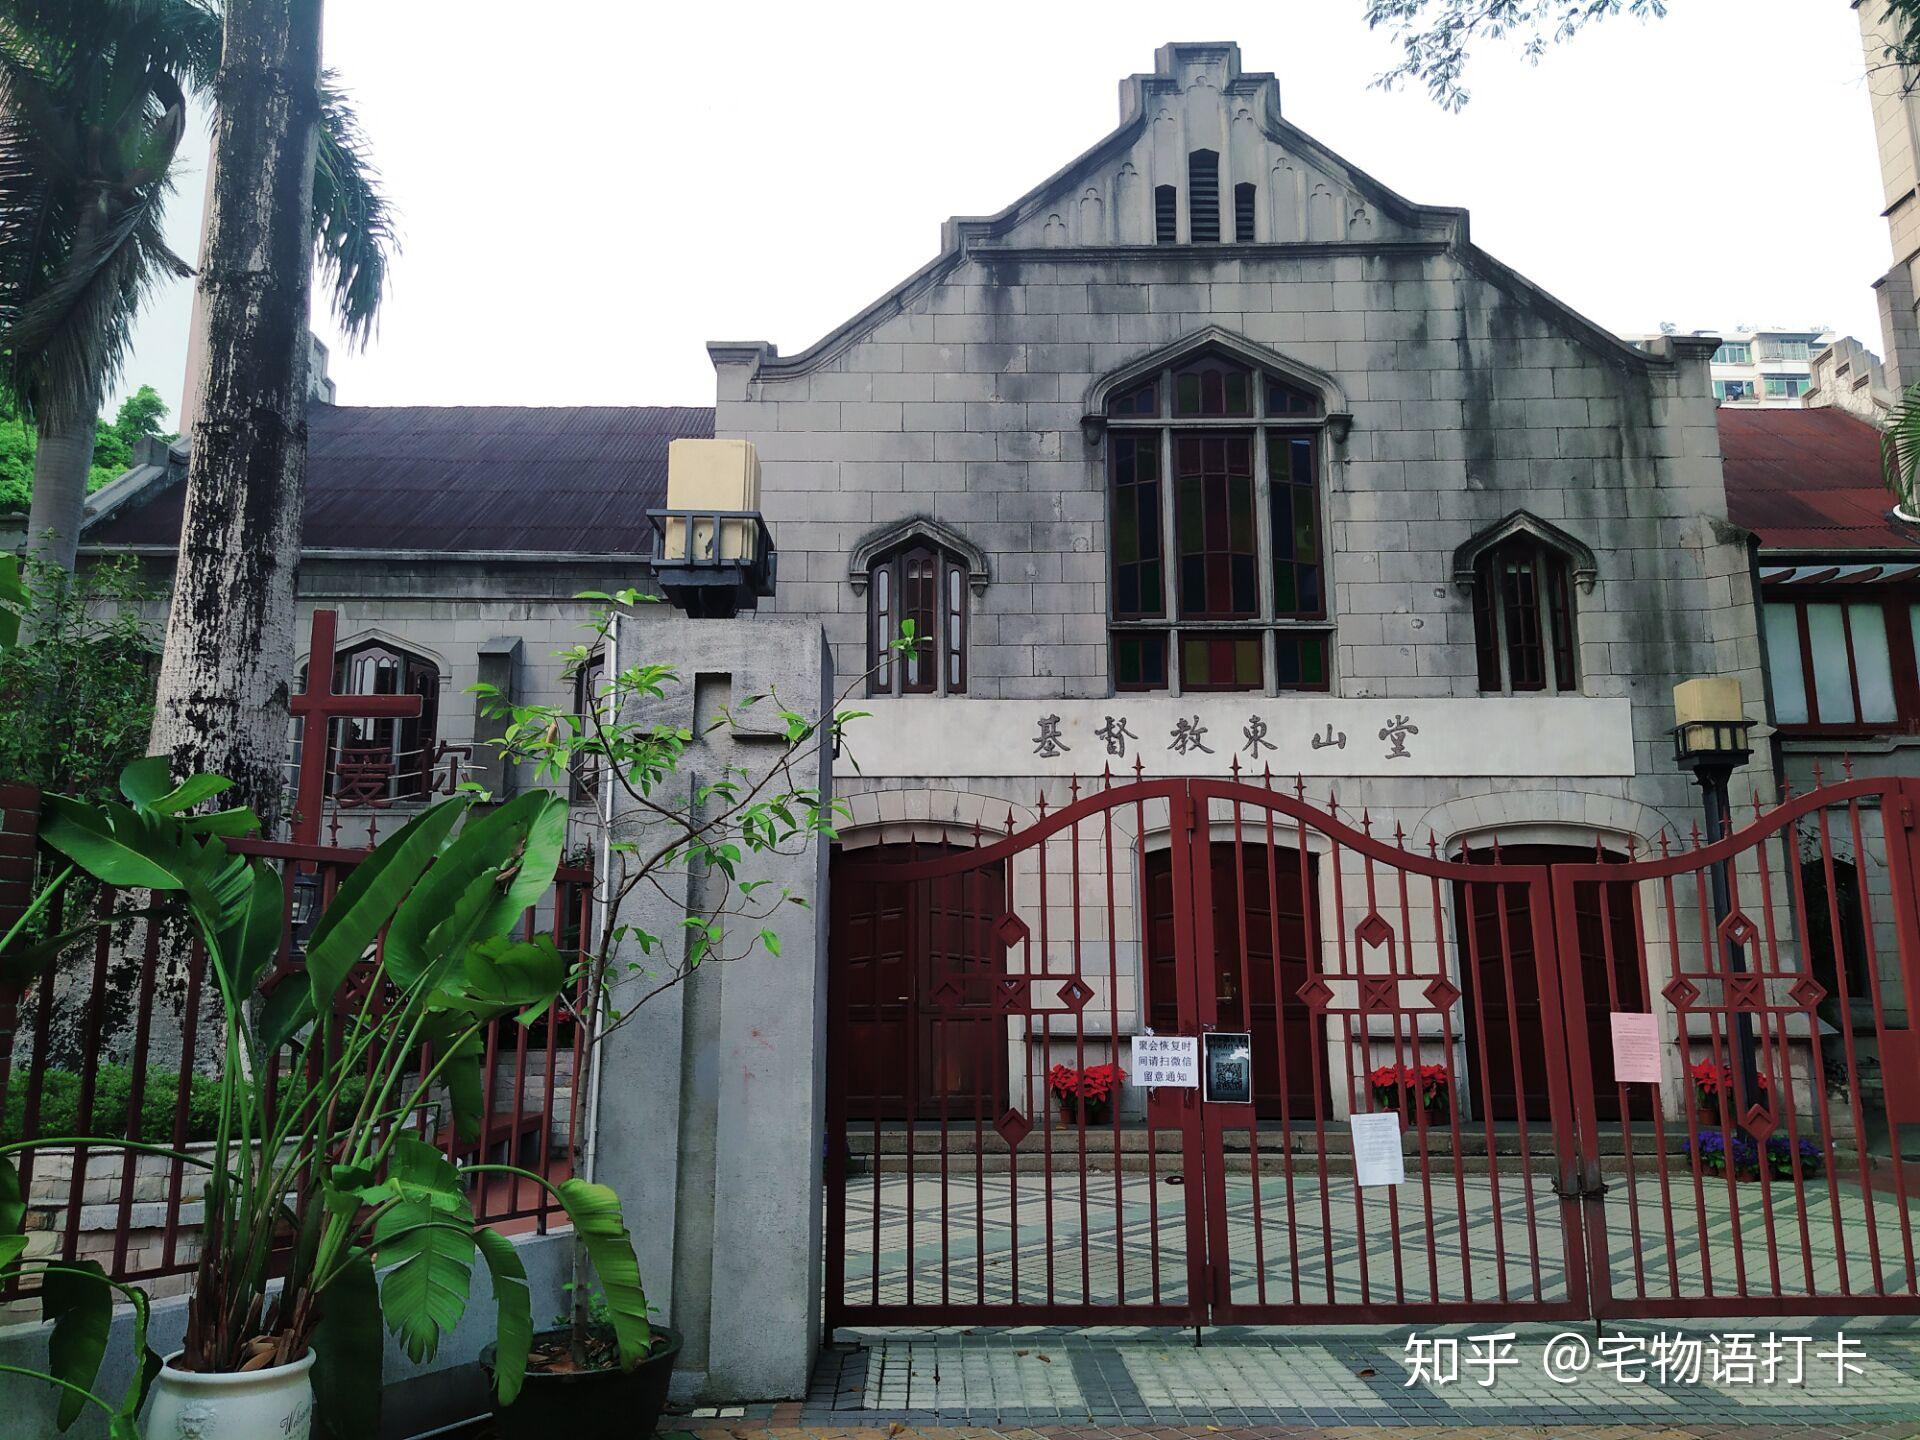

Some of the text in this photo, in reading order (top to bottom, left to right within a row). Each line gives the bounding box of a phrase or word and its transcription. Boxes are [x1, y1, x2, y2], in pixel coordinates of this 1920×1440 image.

[1032, 714, 1419, 759] 基督教東山堂
[1138, 1040, 1191, 1052] 聚会恢复时
[1138, 1055, 1192, 1067] 间请扫微信
[1143, 1071, 1187, 1082] 留意通知
